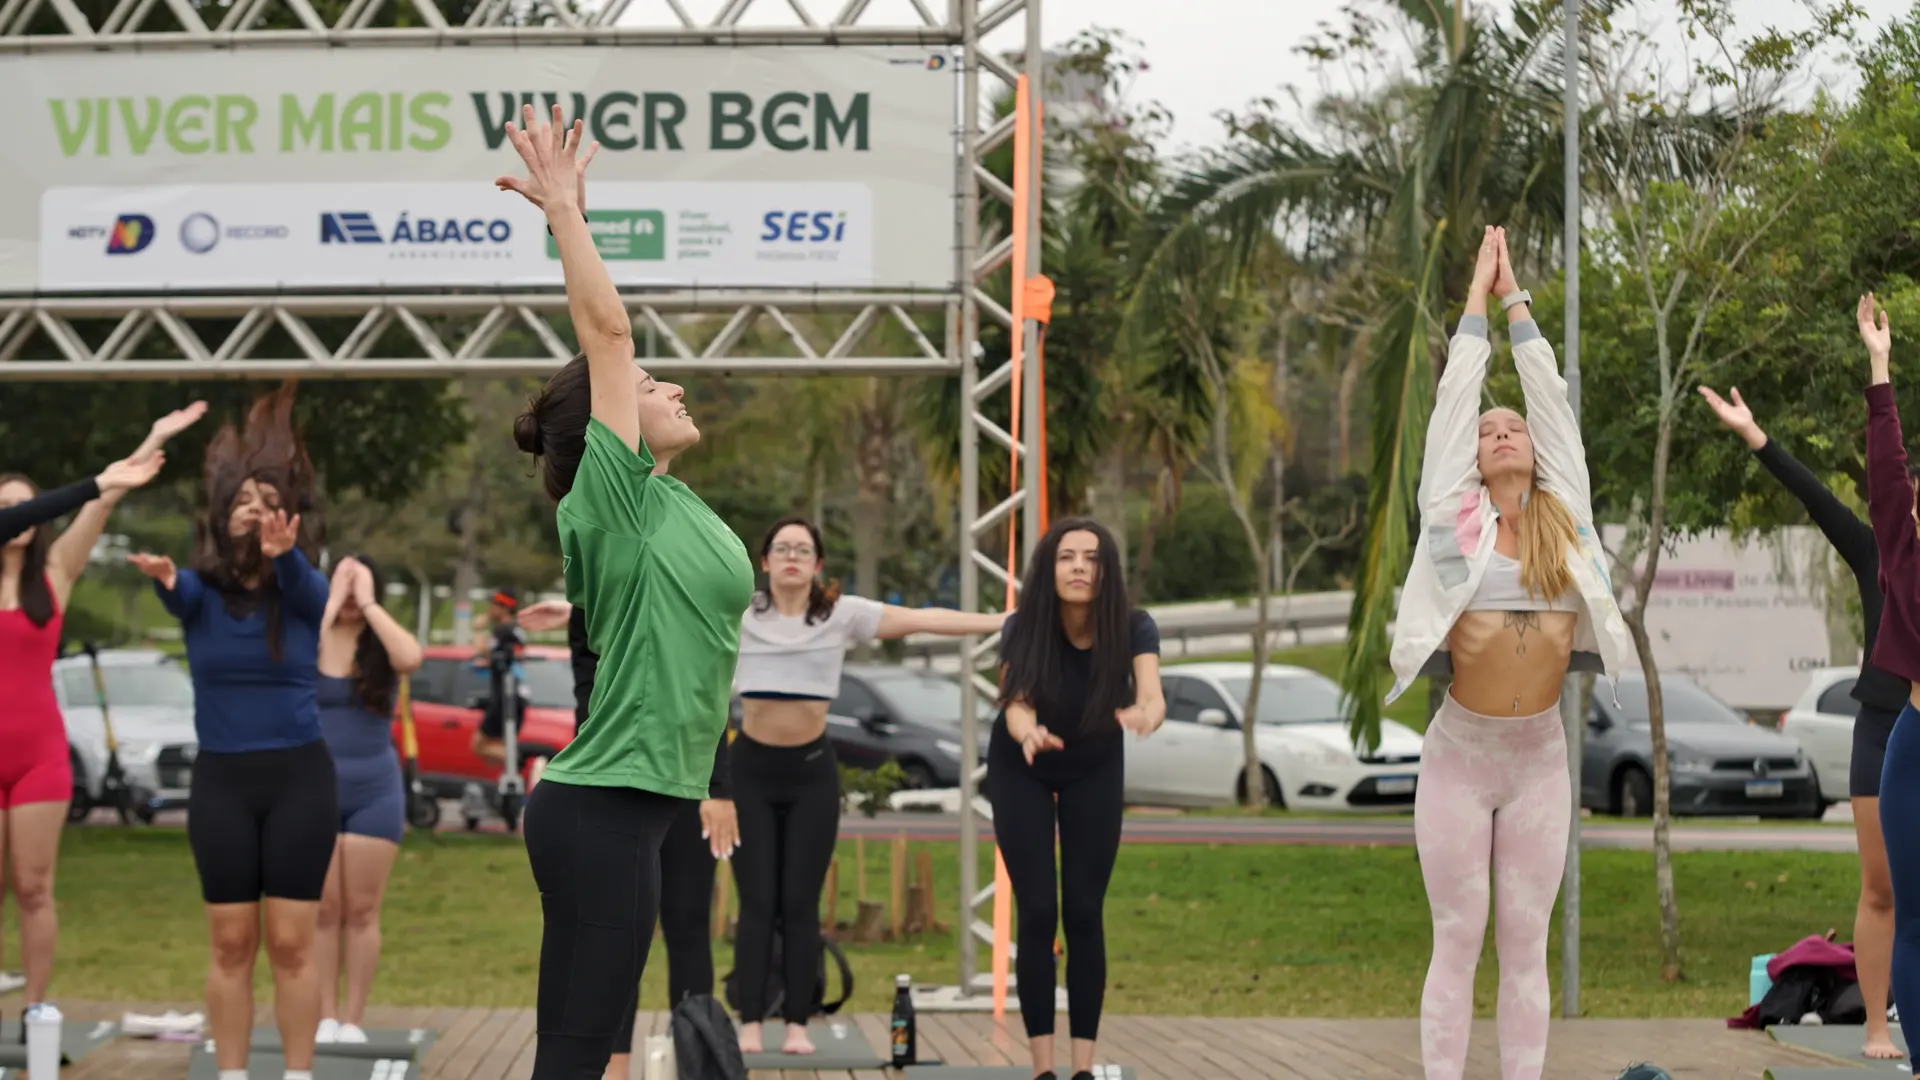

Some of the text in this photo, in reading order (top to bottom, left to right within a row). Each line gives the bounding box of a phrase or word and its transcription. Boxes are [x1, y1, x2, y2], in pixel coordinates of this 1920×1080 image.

[47, 94, 258, 156] VIVER
[280, 91, 452, 153] MAIS
[709, 91, 870, 151] BEM
[226, 225, 290, 239] RECORD
[391, 211, 511, 243] ÁBACO
